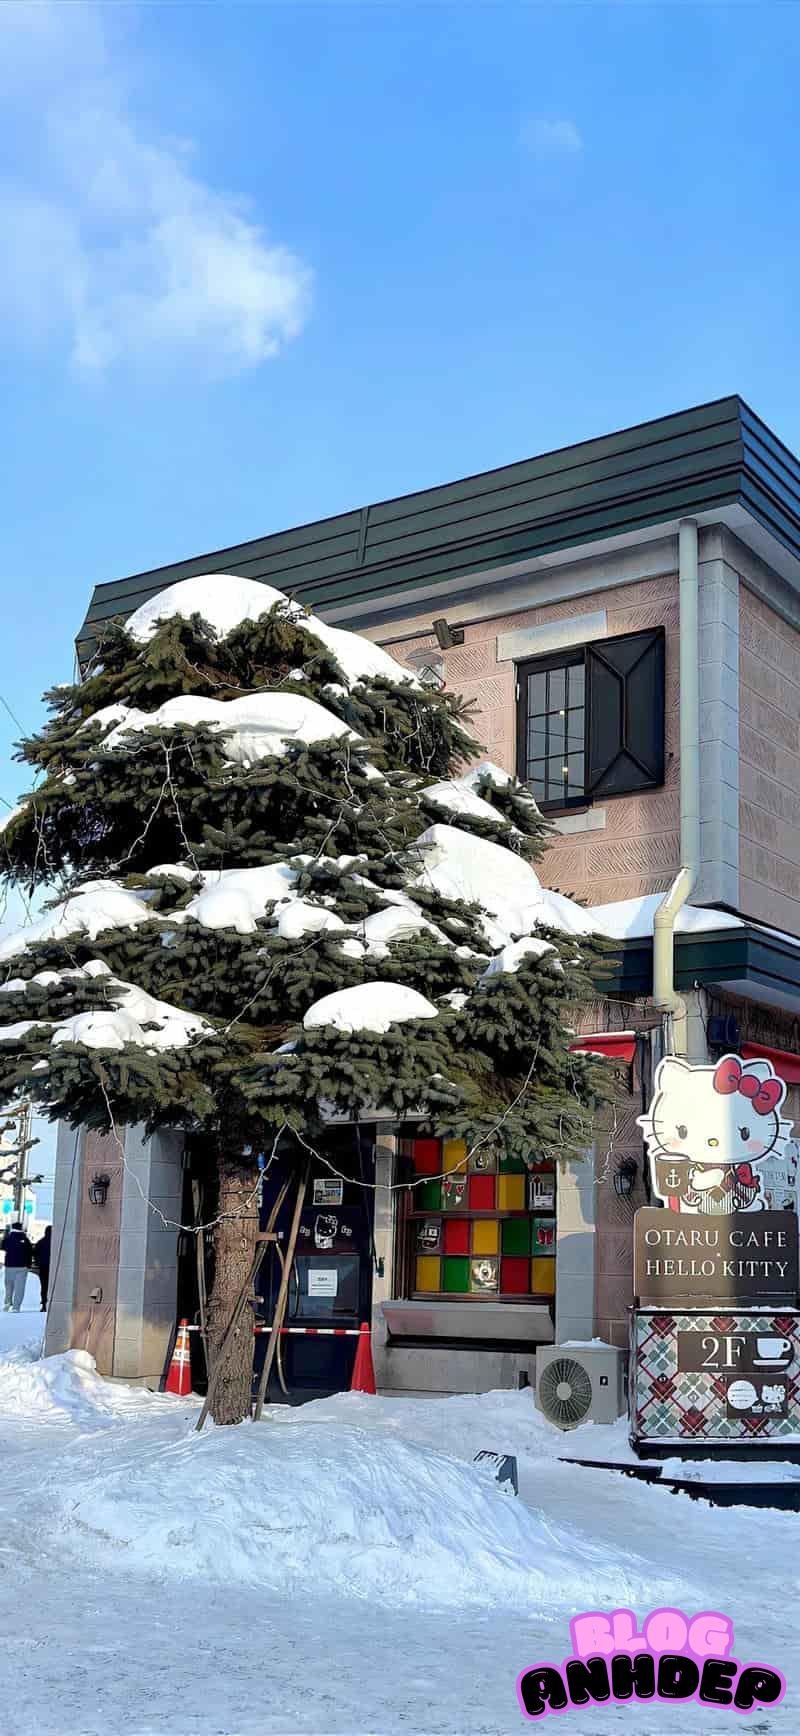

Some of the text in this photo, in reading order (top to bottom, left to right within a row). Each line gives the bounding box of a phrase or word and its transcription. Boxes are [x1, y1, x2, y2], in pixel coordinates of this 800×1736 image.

[644, 1229, 787, 1248] OTARU CAFE
[645, 1259, 789, 1277] HELLO KITTY
[700, 1335, 747, 1369] 2F
